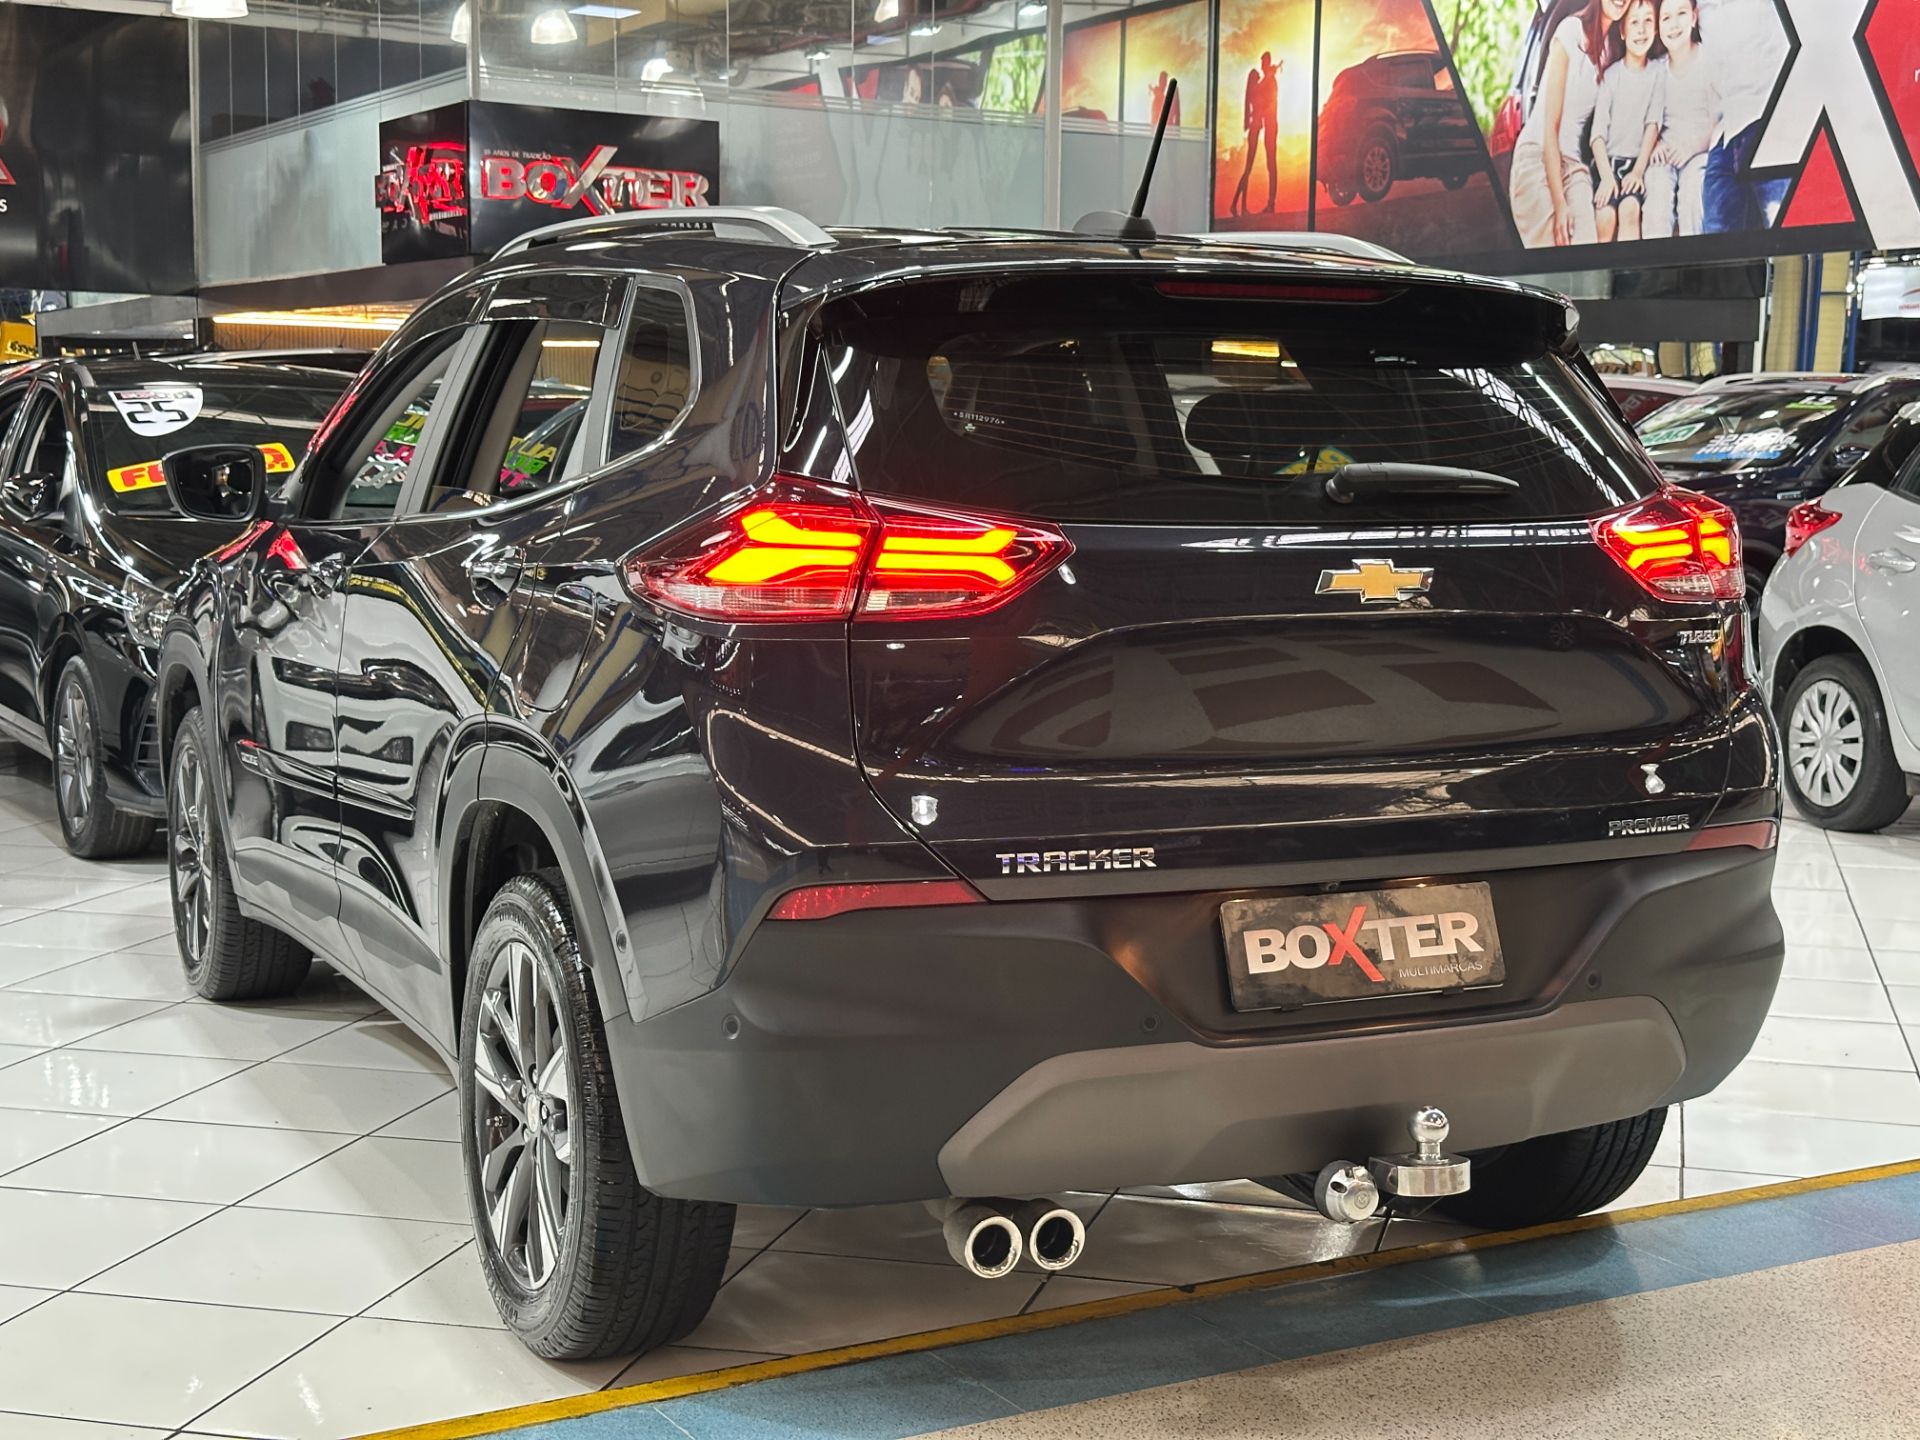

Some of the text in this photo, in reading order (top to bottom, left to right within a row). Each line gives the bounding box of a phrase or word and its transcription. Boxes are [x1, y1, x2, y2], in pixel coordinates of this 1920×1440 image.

[480, 144, 711, 217] BOXTER
[122, 400, 189, 424] 25
[1677, 629, 1721, 645] TURBO
[1608, 813, 1691, 837] PREMIER
[995, 847, 1157, 874] TRACKER
[1243, 905, 1485, 982] BOXTER
[1399, 961, 1484, 979] MULTIMARCAS
